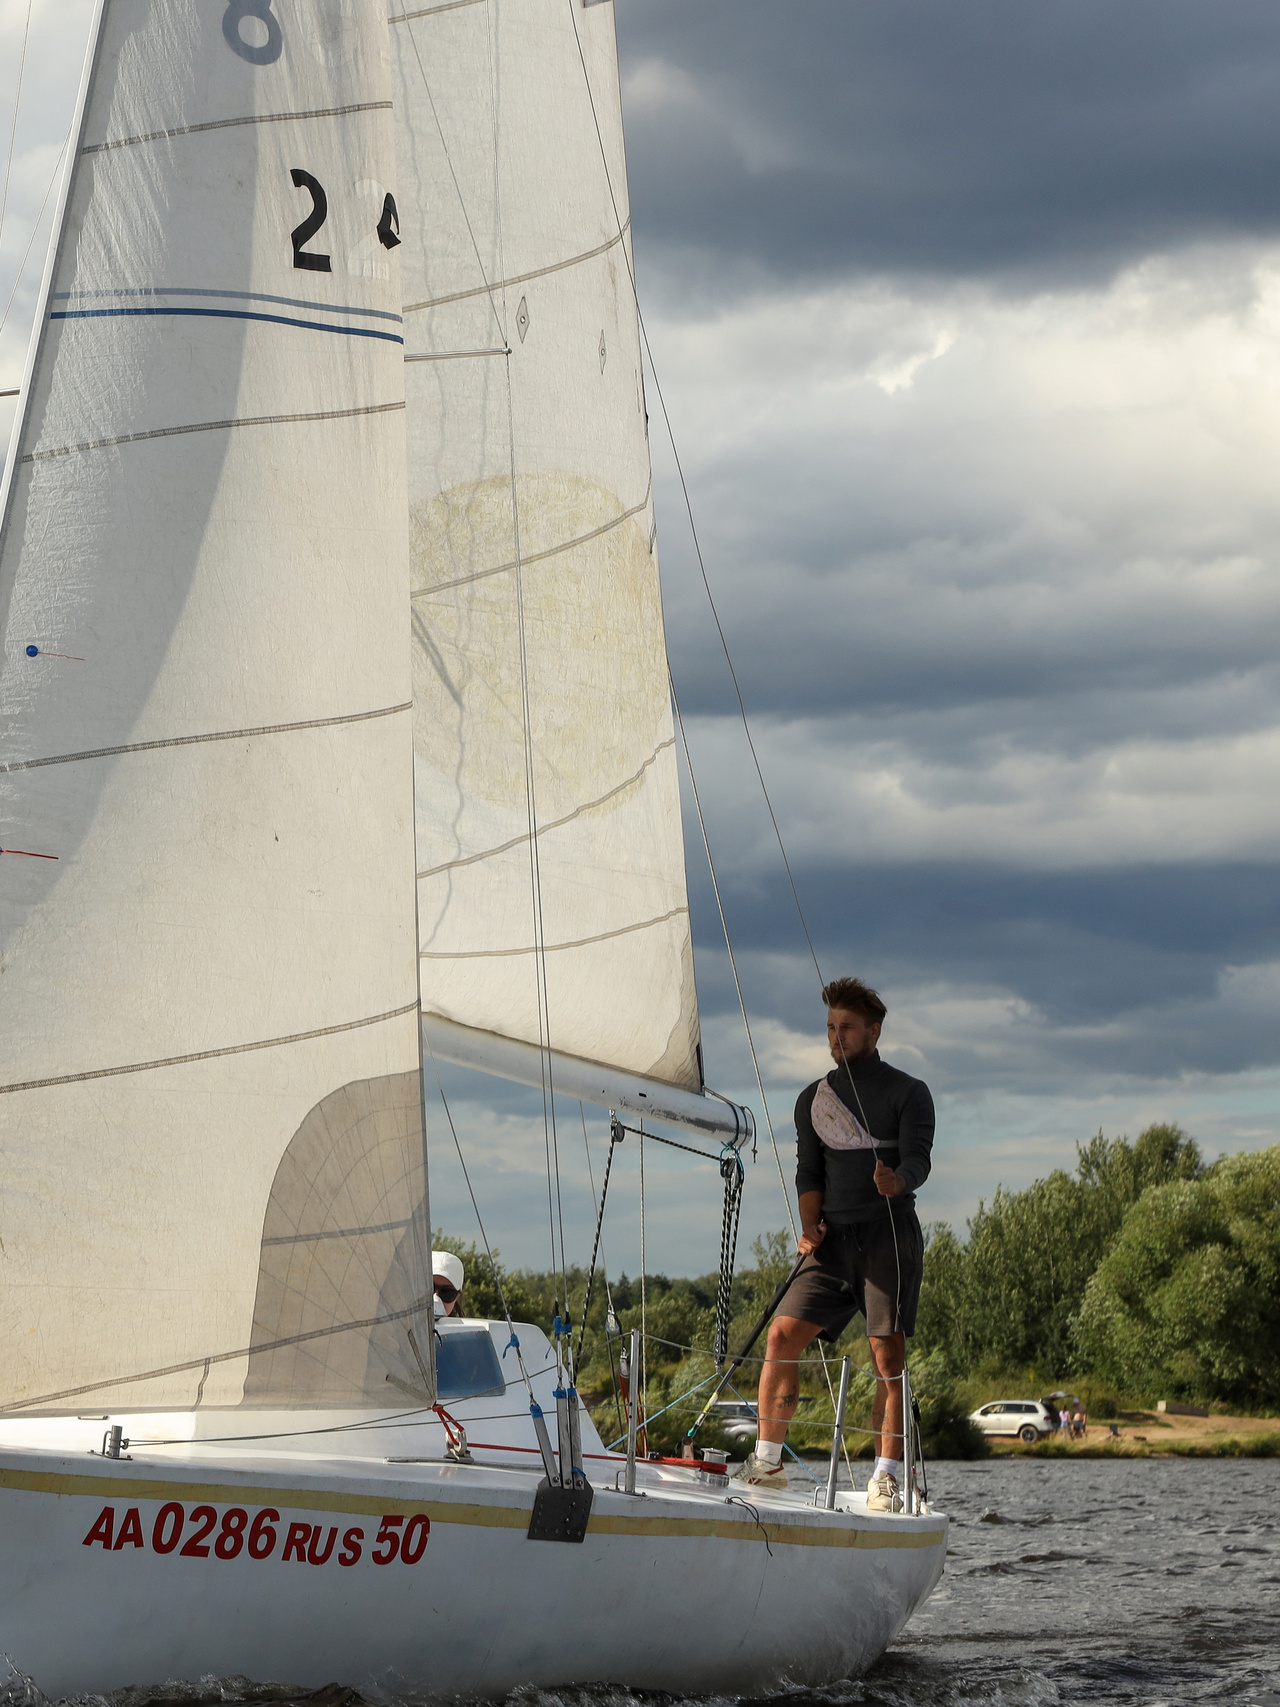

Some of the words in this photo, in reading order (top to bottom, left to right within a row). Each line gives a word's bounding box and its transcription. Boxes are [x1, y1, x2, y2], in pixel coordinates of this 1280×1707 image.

[151, 1502, 280, 1560] 0286
[282, 1522, 363, 1567] RUS
[371, 1513, 431, 1565] 50
